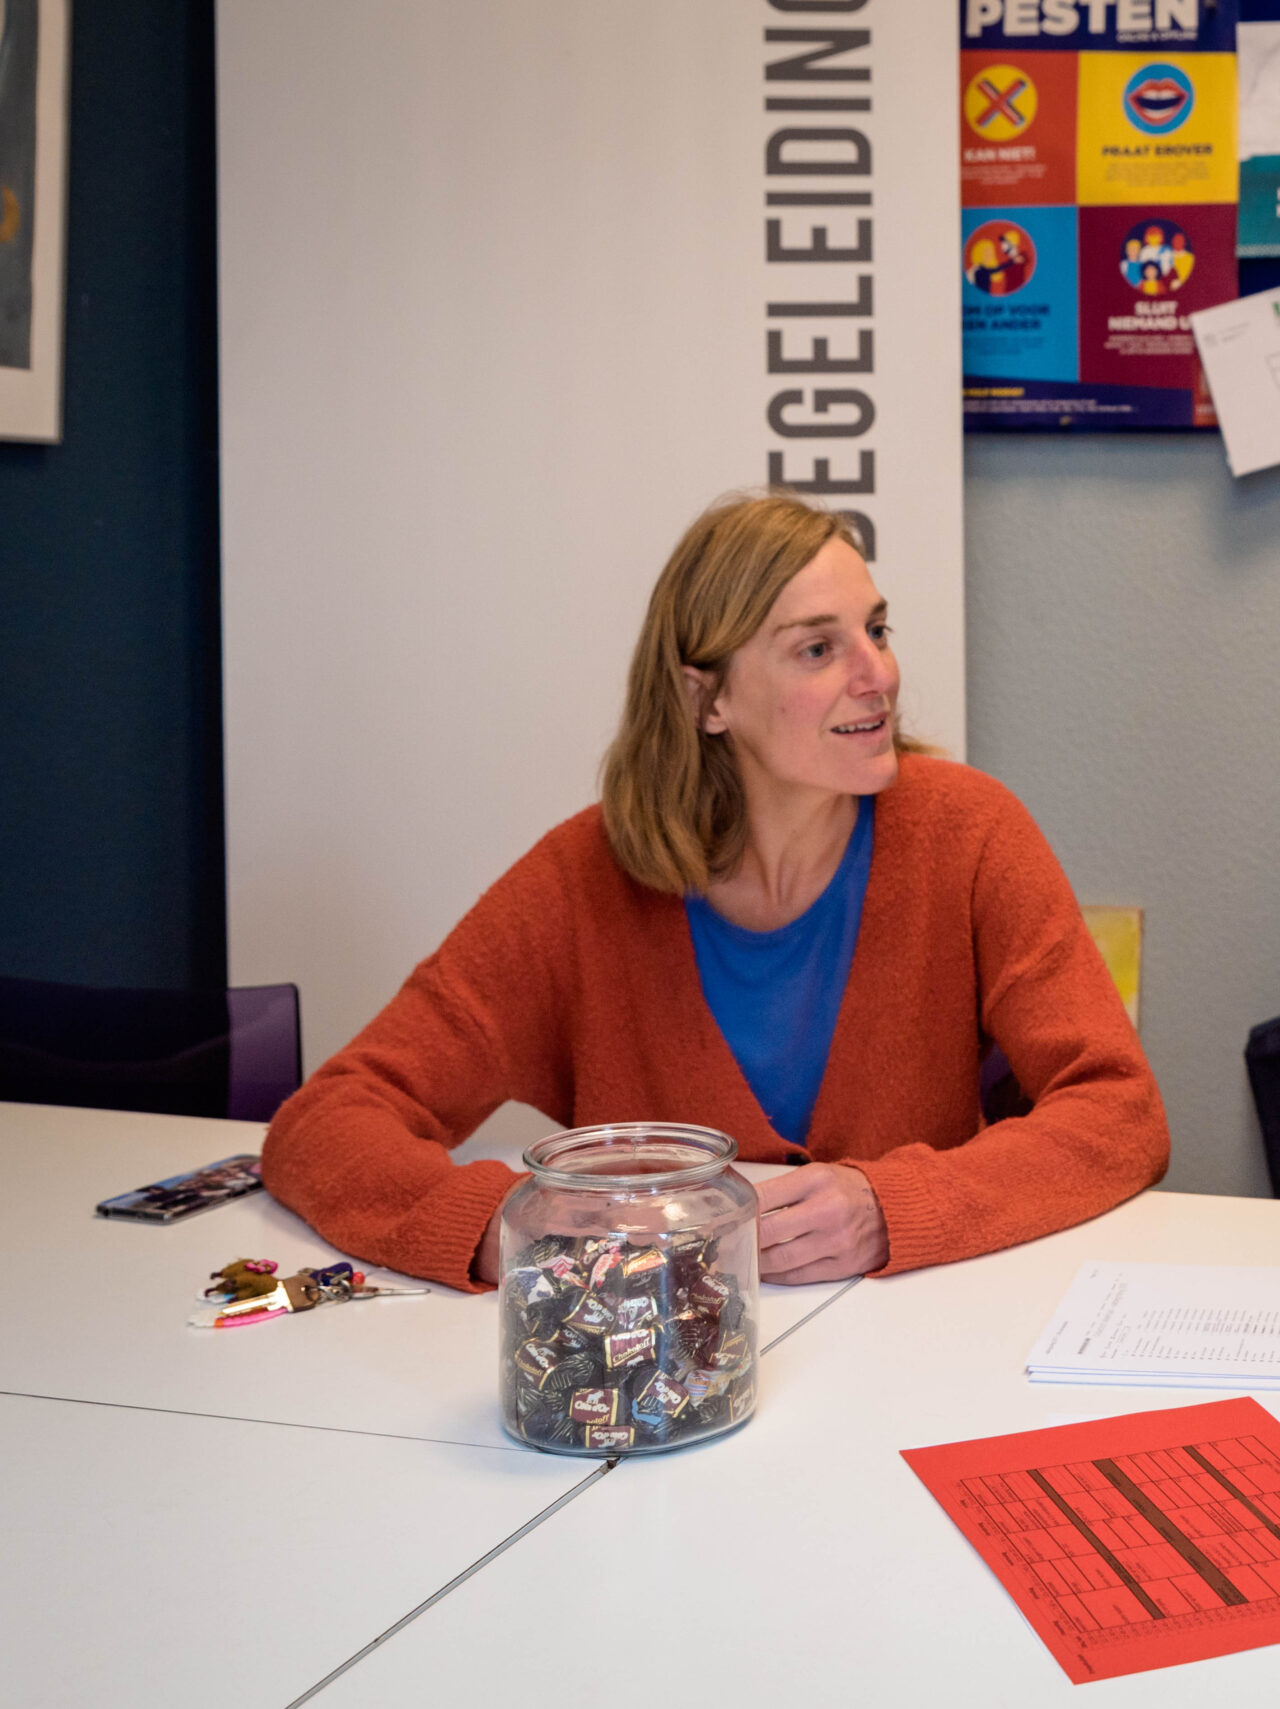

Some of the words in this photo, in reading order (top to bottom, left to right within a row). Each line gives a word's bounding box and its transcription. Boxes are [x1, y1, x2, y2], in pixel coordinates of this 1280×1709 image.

[966, 0, 1199, 37] PESTEN
[1102, 145, 1150, 157] PRAAT
[1154, 143, 1213, 157] EROVER
[1135, 301, 1178, 315] SLUIT
[1108, 317, 1177, 331] NIEMAND
[613, 1337, 650, 1362] Chokotoff
